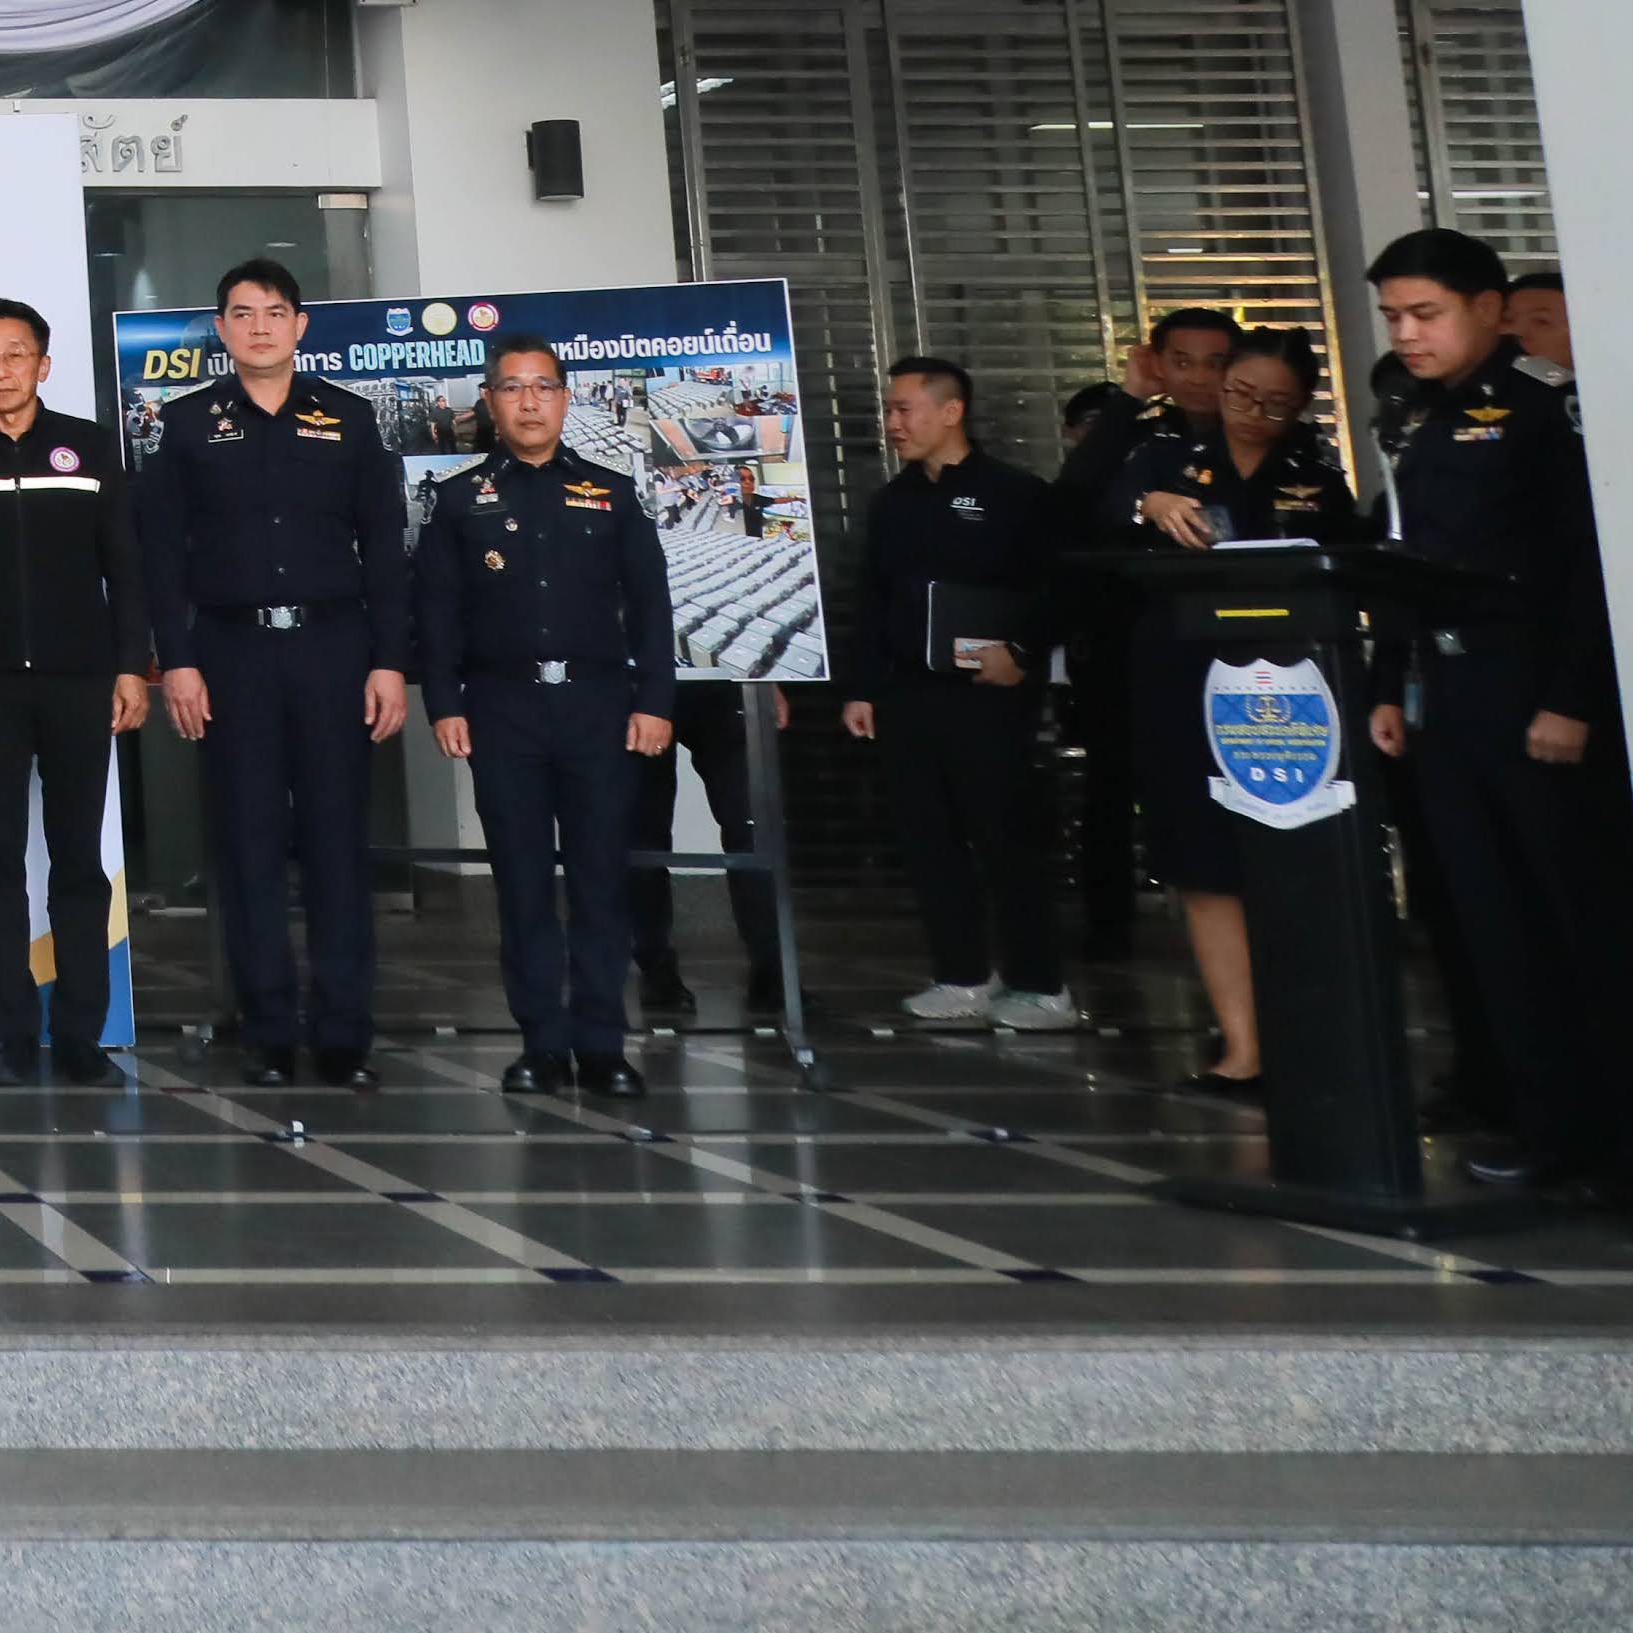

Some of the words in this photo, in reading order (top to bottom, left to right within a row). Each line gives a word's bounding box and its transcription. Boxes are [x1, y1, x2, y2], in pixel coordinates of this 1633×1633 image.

[143, 347, 202, 380] DSI
[348, 338, 485, 372] COPPERHEAD
[952, 497, 976, 507] DSI
[1249, 766, 1304, 783] DSI
